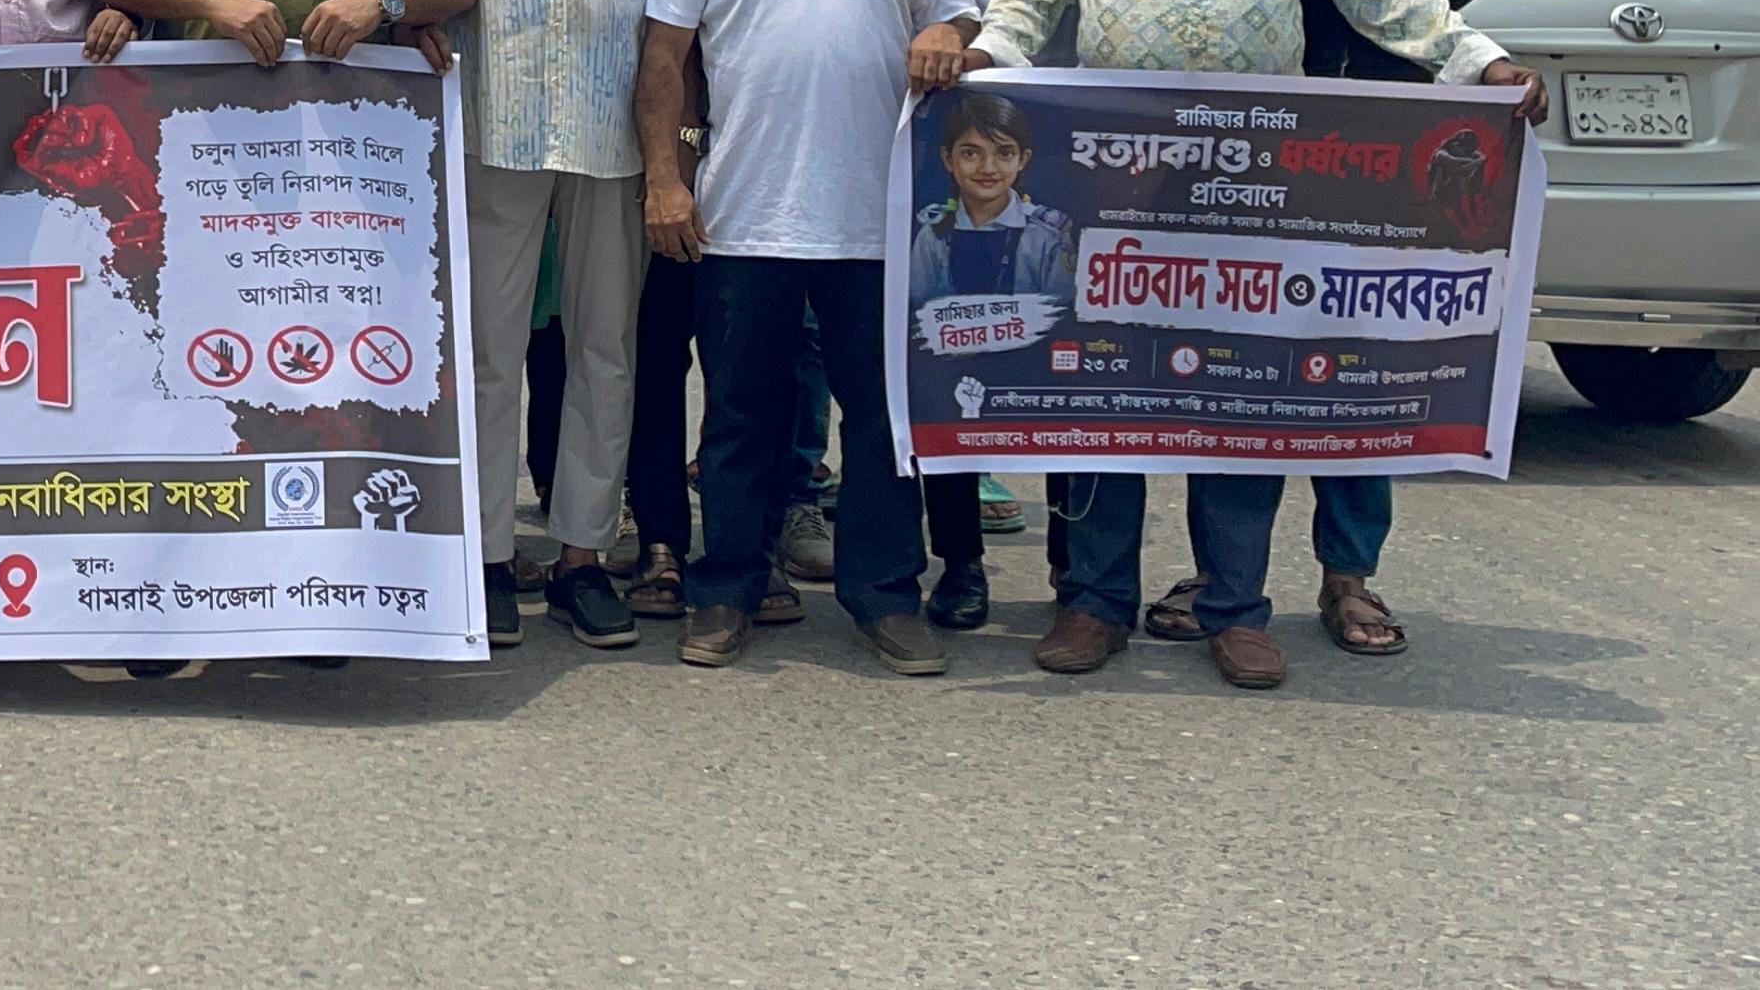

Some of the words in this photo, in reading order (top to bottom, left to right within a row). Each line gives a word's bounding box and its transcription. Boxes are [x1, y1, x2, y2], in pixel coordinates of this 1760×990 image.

[1175, 105, 1245, 129] রামিছার
[1250, 107, 1299, 131] নির্মম
[190, 143, 236, 166] চলুন
[242, 139, 301, 159] আমরা
[308, 135, 357, 160] সবাই
[362, 137, 404, 164] মিলে
[1070, 131, 1251, 173] হত্যাকাণ্ড
[1257, 150, 1272, 168] ও
[1279, 129, 1402, 183] ধর্ষণের
[186, 178, 228, 200] গড়ে
[234, 172, 275, 201] তুলি
[281, 170, 354, 194] নিরাপদ
[359, 177, 414, 205] সমাজ,
[1190, 176, 1288, 208] প্রতিবাদে
[200, 211, 302, 236] মাদকমুক্ত
[309, 210, 406, 235] বাংলাদেশ
[1157, 212, 1186, 224] সকল
[1189, 211, 1230, 227] নাগরিক
[1231, 215, 1263, 228] সমাজ
[1266, 219, 1276, 229] ও
[1279, 216, 1327, 232] সামাজিক
[1329, 219, 1382, 236] সংগঠনের
[1383, 222, 1427, 238] উদ্যোগে
[225, 252, 243, 269] ও
[251, 243, 385, 272] সহিংসতামুক্ত
[238, 278, 329, 306] আগামীর
[338, 285, 382, 306] স্বপ্ন!
[1086, 237, 1209, 309] প্রতিবাদ
[1216, 258, 1283, 315] সভা
[1290, 281, 1309, 301] ও
[1321, 266, 1493, 327] মানববন্ধন
[934, 301, 985, 324] রামিছার
[988, 300, 1020, 316] জন্য
[939, 324, 988, 349] বিচার
[992, 317, 1025, 342] চাই
[1083, 358, 1106, 372] ২৩
[1111, 358, 1130, 372] মে
[1206, 364, 1242, 379] সকাল
[1244, 367, 1263, 380] ১০
[1266, 366, 1280, 381] টা
[1338, 370, 1378, 385] ধামরাই
[1381, 370, 1428, 384] উপজেলা
[1431, 365, 1467, 379] পরিষদ
[991, 392, 1040, 409] দোষীদের
[1042, 394, 1065, 408] দ্রুত
[1174, 395, 1203, 411] শাস্তি
[1207, 401, 1217, 412] ও
[1221, 398, 1268, 415] নারীদের
[1399, 401, 1420, 415] চাই
[1032, 428, 1109, 447] ধামরাইয়ের
[1114, 432, 1153, 447] সকল
[1158, 430, 1217, 448] নাগরিক
[1223, 435, 1267, 450] সমাজ
[1272, 439, 1284, 451] ও
[1290, 433, 1356, 452] সামাজিক
[1360, 431, 1414, 450] সংগঠন
[161, 476, 250, 523] সংস্থা
[78, 581, 166, 614] ধামরাই
[173, 580, 277, 610] উপজেলা
[286, 576, 370, 608] পরিষদ
[375, 583, 429, 616] চত্বর
